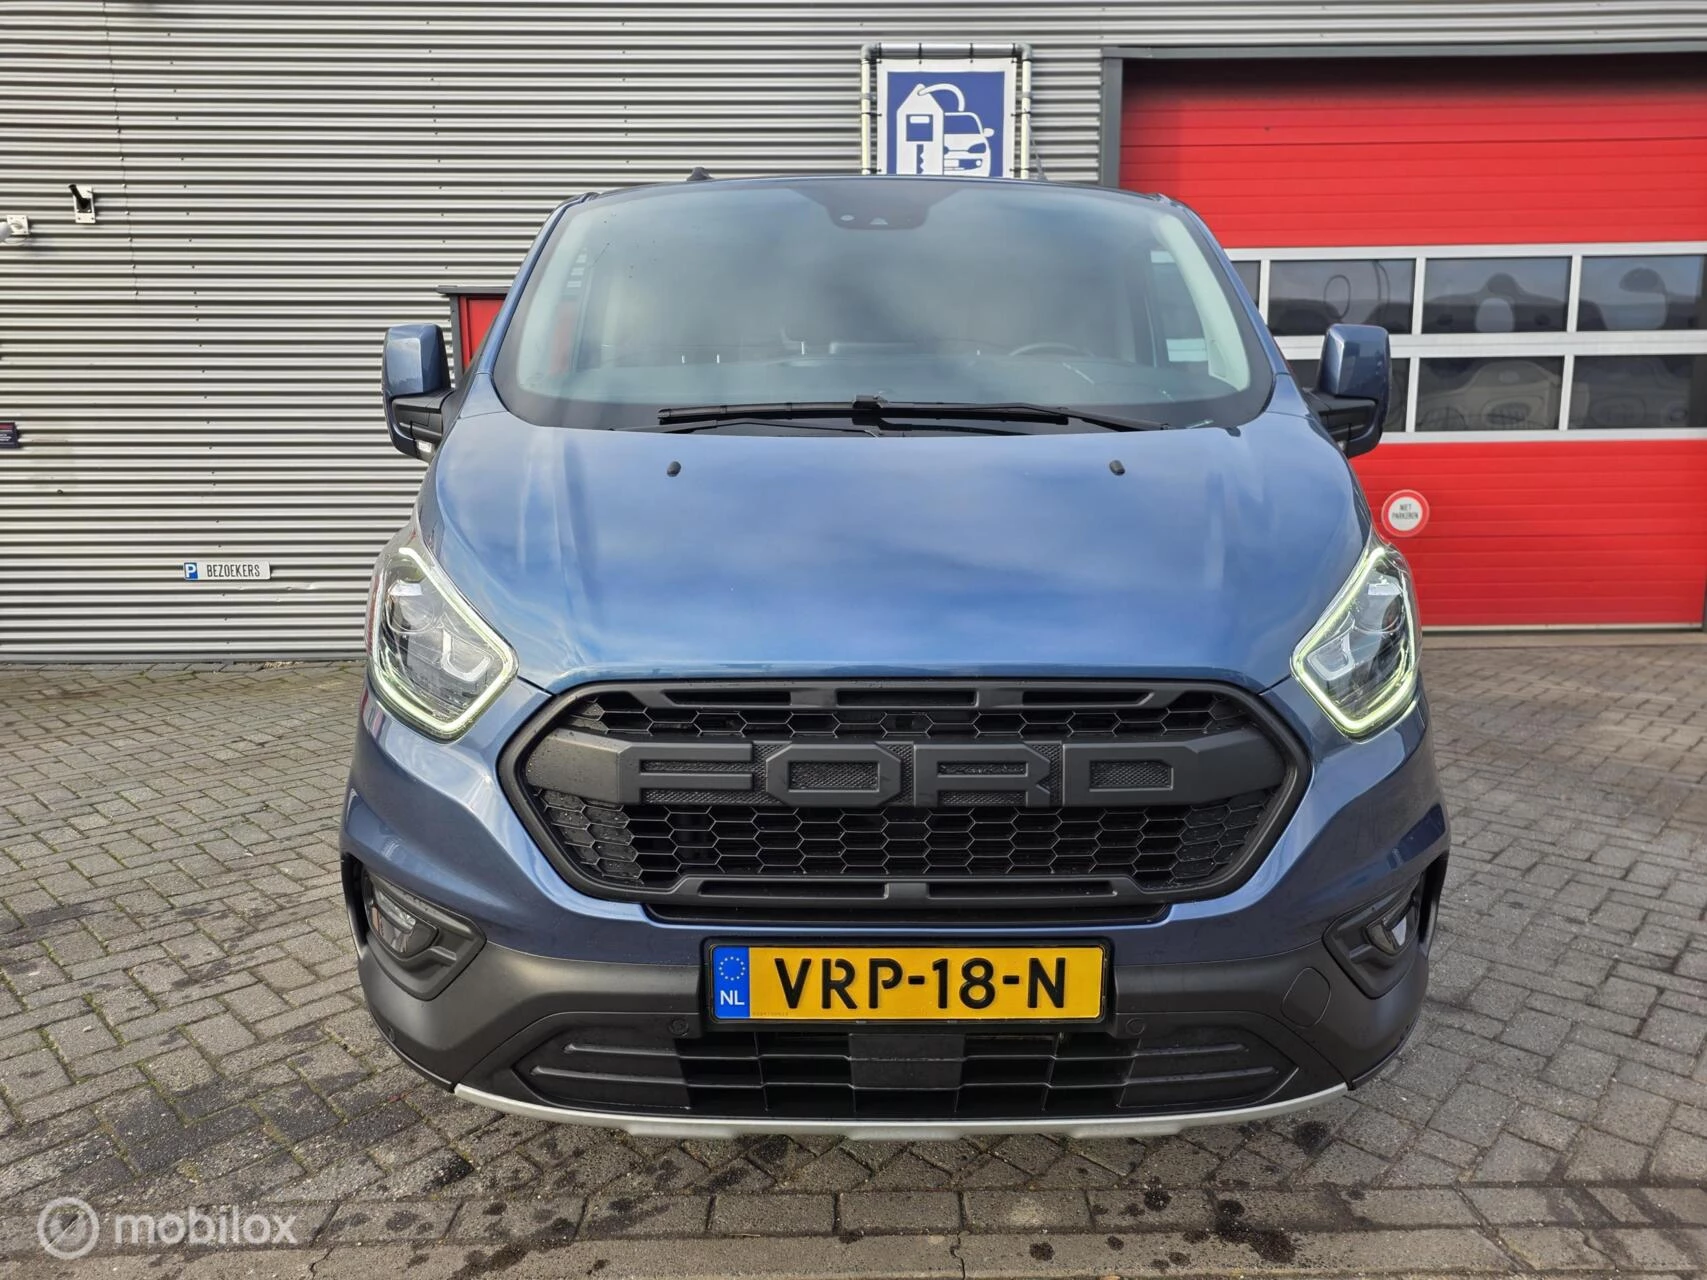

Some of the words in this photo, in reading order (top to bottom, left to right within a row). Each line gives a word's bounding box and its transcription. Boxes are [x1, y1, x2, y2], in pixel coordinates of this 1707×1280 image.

[185, 564, 197, 578] P
[207, 564, 260, 577] BEZOEKERS
[618, 740, 1175, 808] FORD
[719, 989, 745, 1006] NL
[774, 957, 1066, 1010] VRP-18-N
